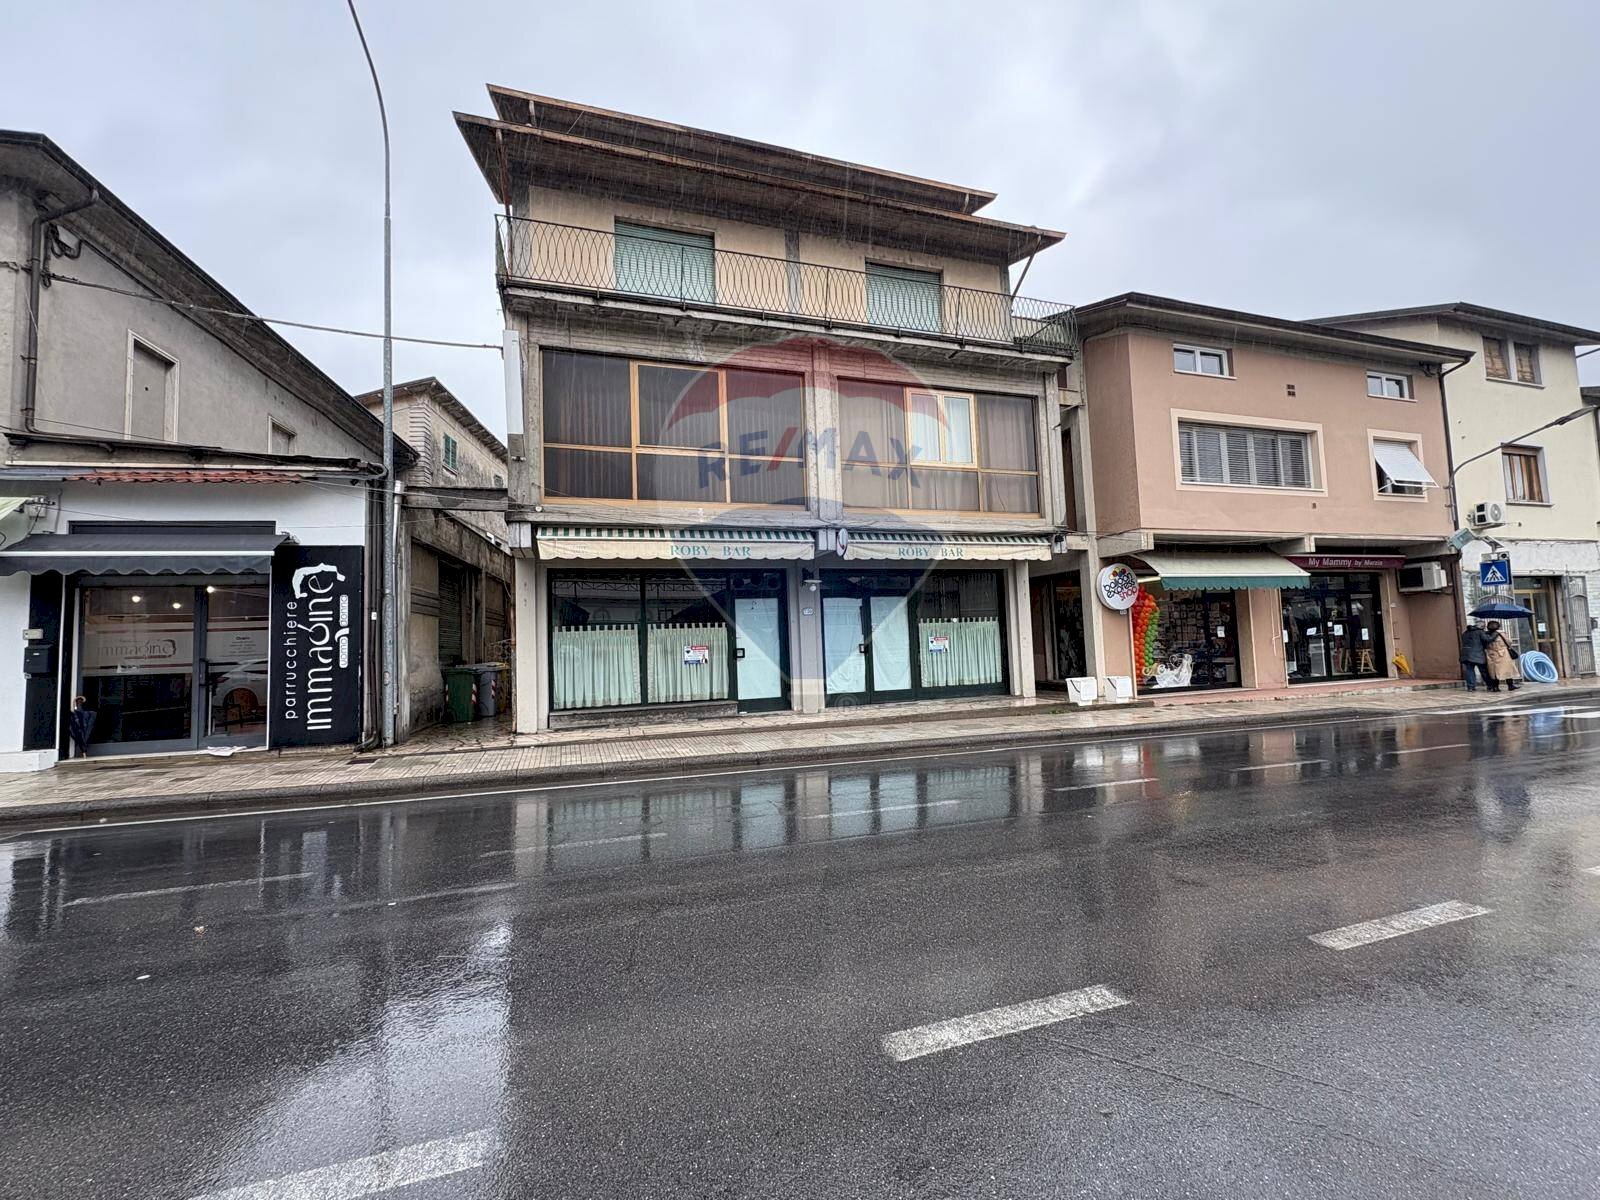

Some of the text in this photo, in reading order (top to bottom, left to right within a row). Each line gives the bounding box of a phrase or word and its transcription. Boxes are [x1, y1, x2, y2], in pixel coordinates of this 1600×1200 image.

[670, 545, 751, 557] ROBY BAR
[898, 547, 964, 557] ROBY BAR
[1308, 558, 1320, 567] My
[1322, 558, 1353, 568] Mammy
[1103, 572, 1133, 591] balloon
[1119, 586, 1137, 600] shop
[283, 601, 299, 720] parrucchiere
